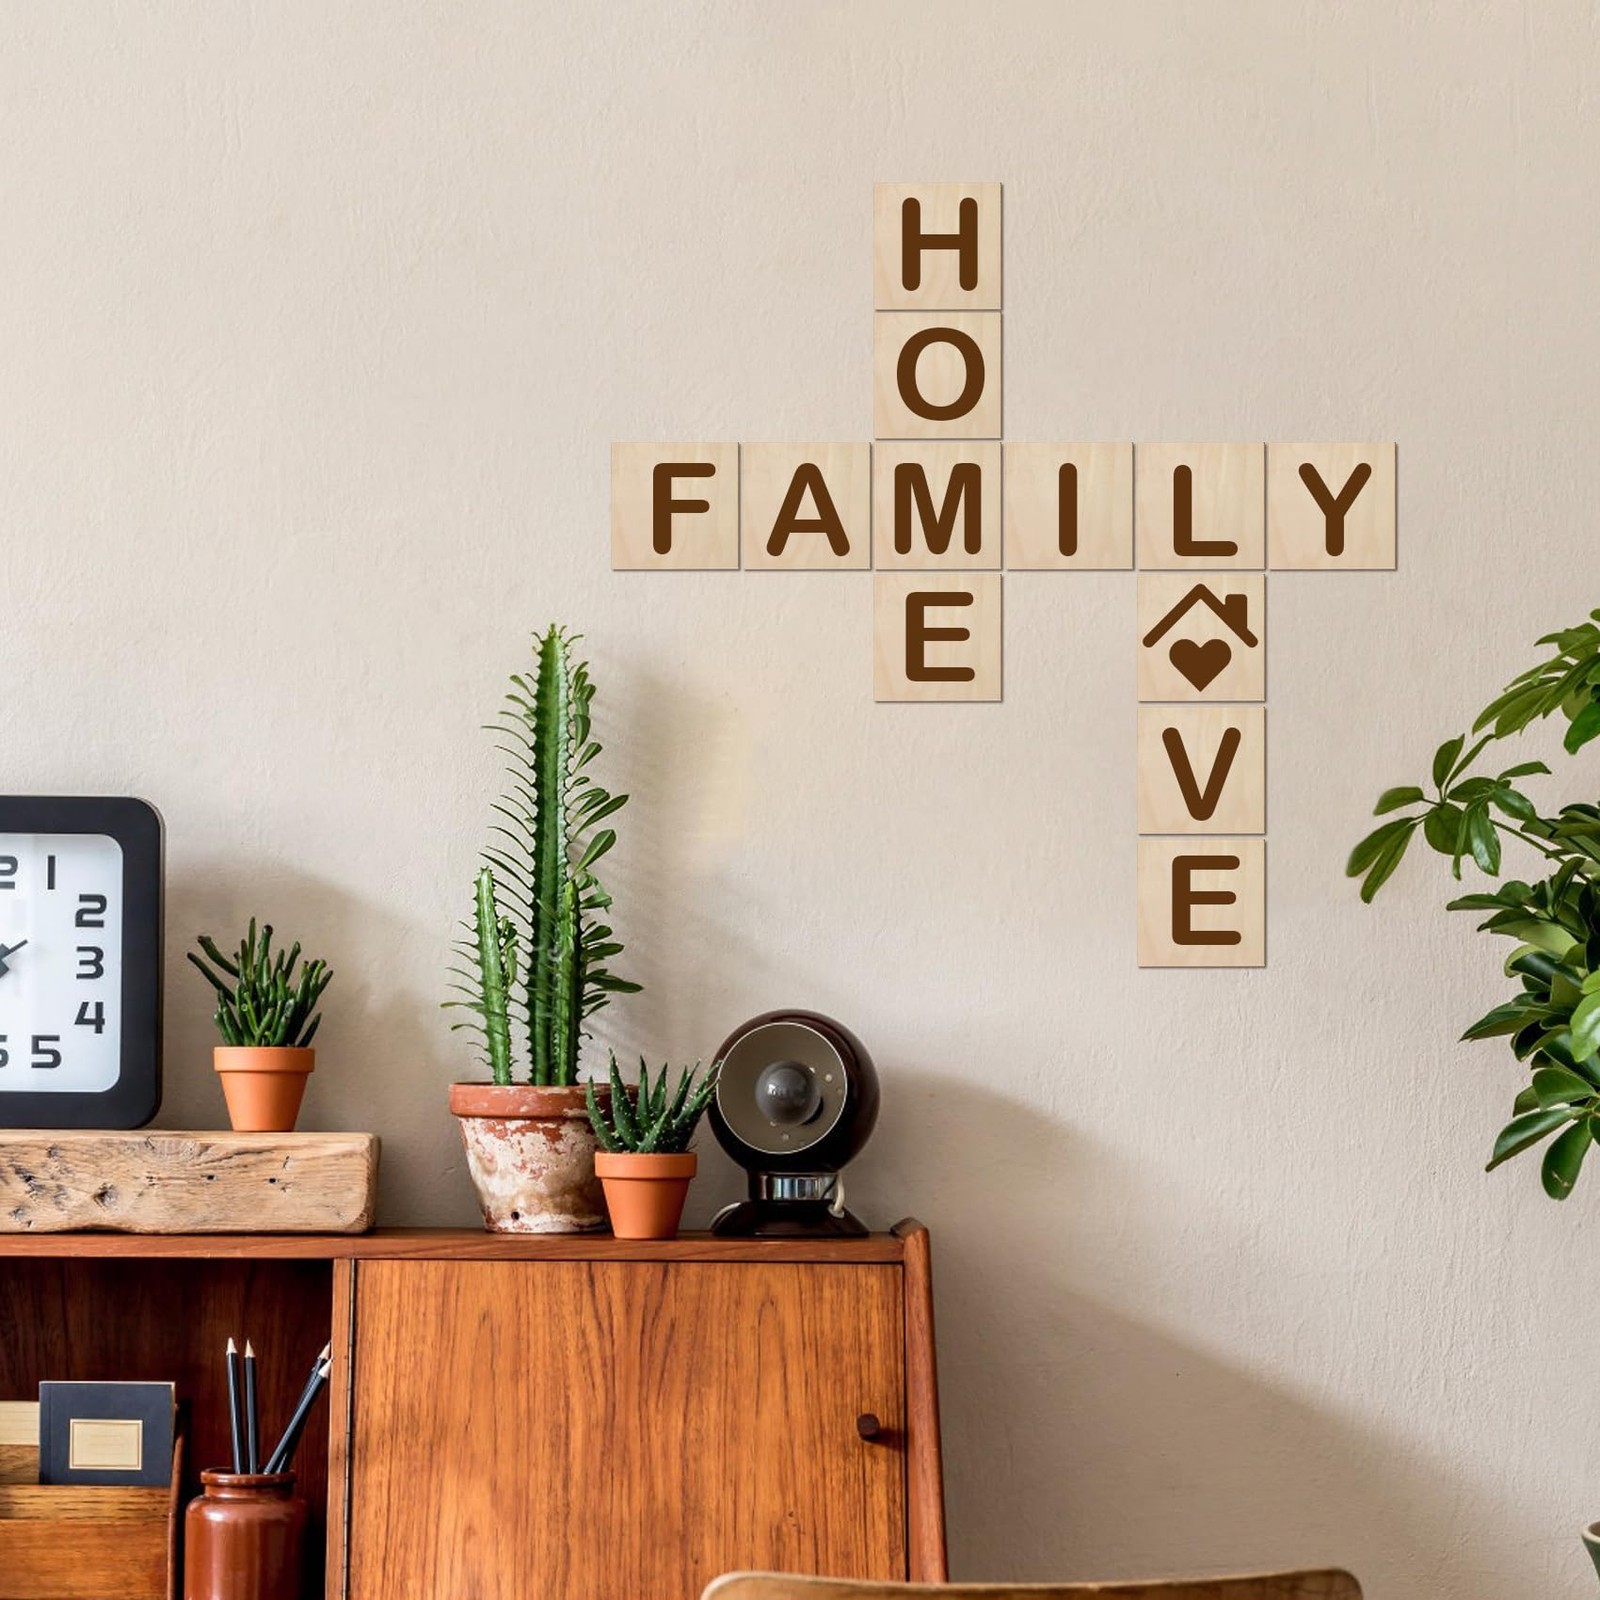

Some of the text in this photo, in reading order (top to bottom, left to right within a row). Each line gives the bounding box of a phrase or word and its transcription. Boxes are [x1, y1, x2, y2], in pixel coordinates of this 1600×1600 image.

[895, 198, 985, 682] HOME
[653, 463, 1372, 557] FAMILY
[47, 855, 56, 890] 1
[75, 894, 108, 928] 2
[76, 946, 104, 980] 3
[74, 1001, 106, 1035] 4
[31, 1034, 62, 1069] 5
